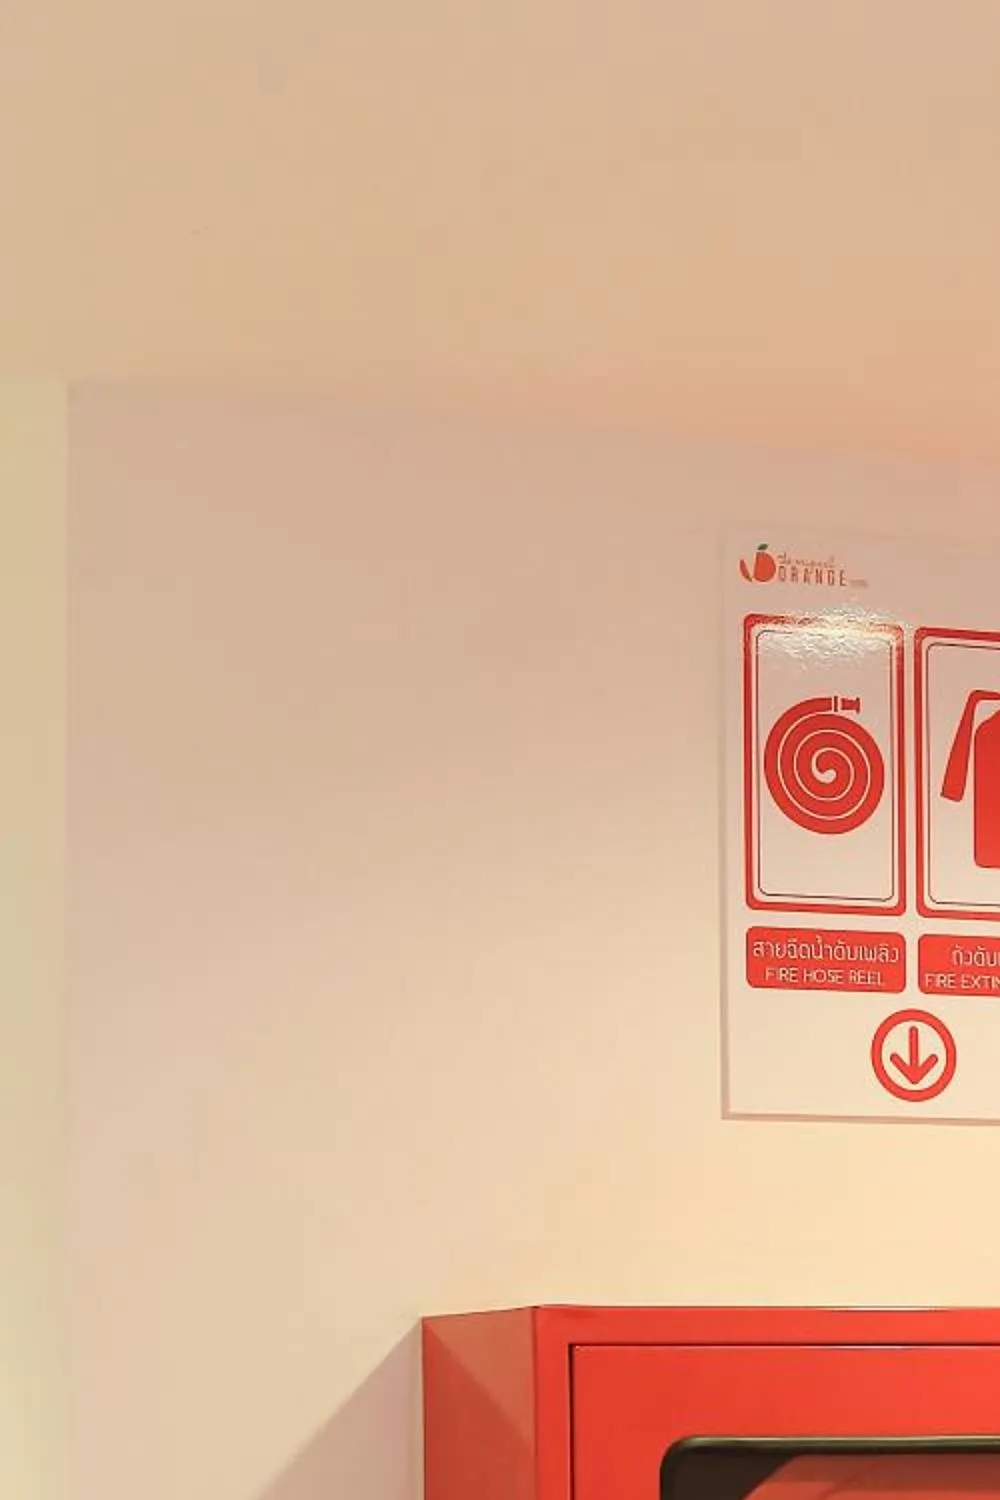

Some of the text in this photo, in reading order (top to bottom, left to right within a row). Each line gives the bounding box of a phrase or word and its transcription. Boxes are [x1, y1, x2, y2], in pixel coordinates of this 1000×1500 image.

[779, 565, 847, 587] ORANGE
[753, 935, 899, 963] สายฉีดน้ำดับเพลิง
[765, 967, 885, 986] FIRE HOSE REEL
[925, 974, 956, 989] FIRE
